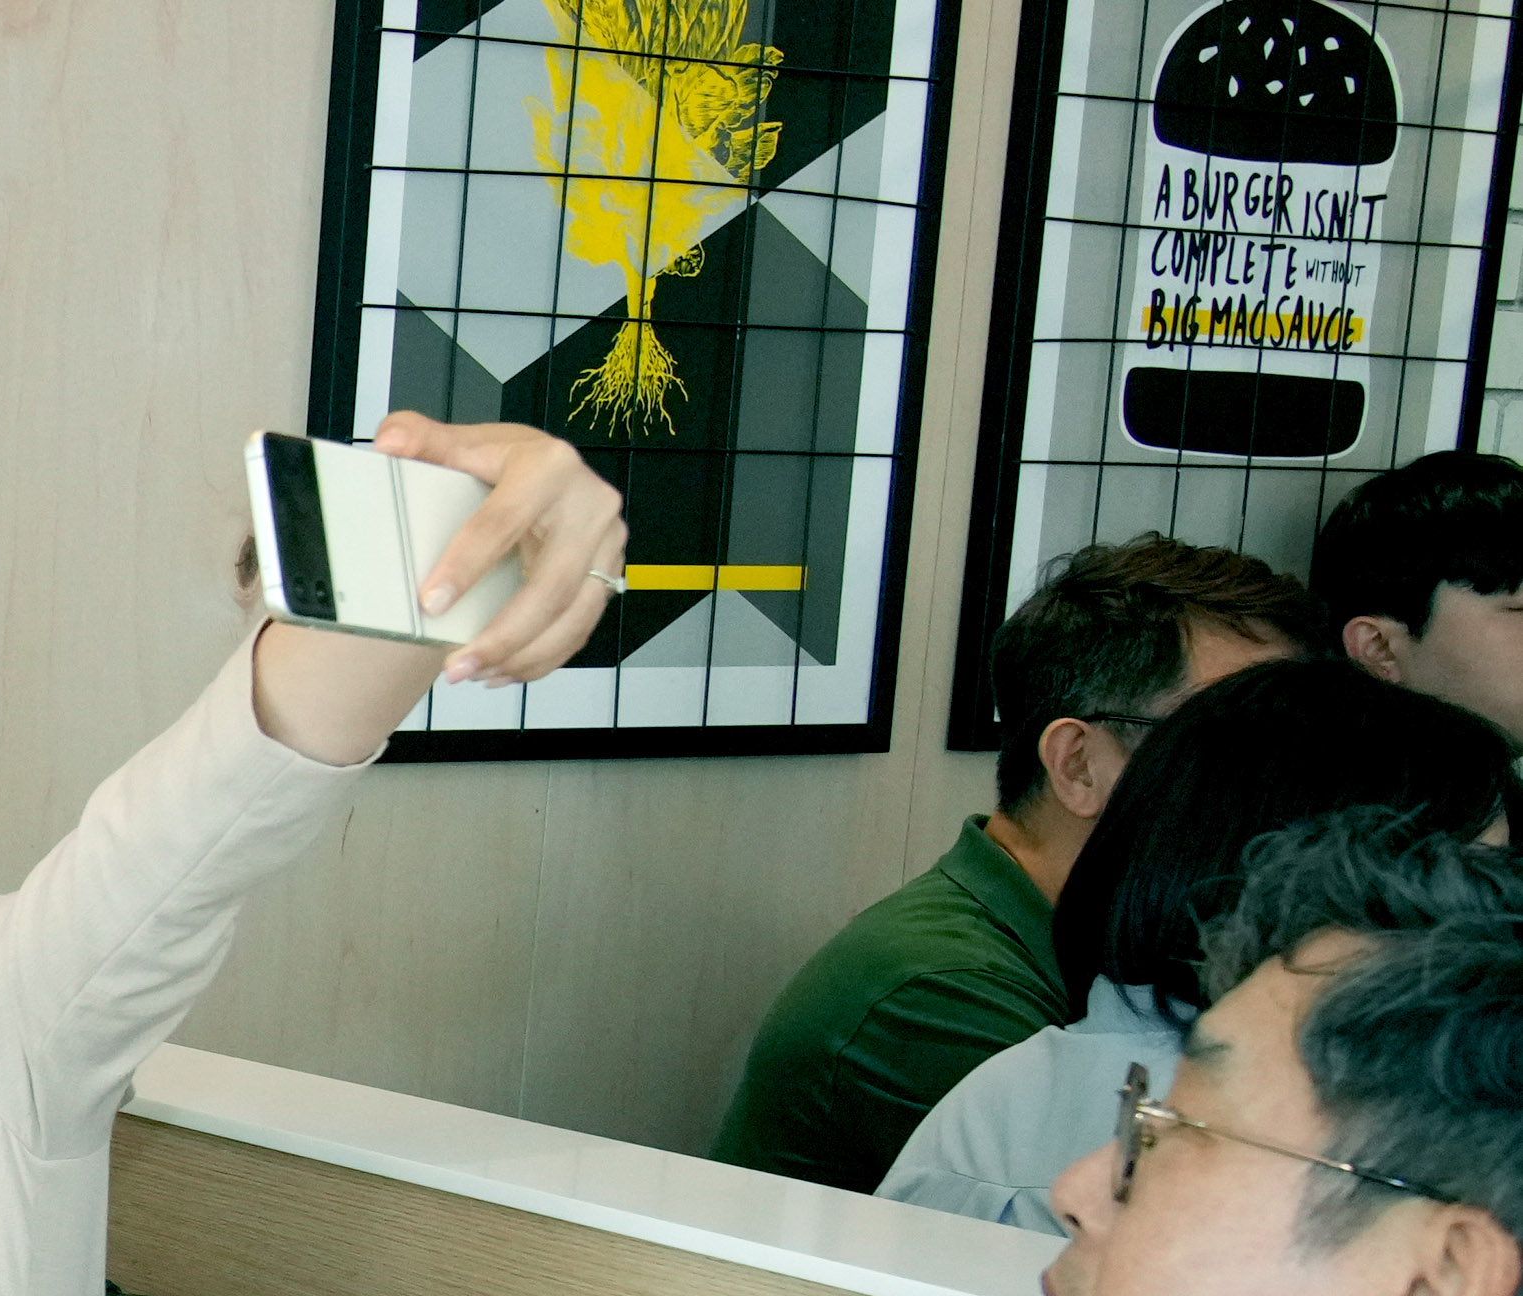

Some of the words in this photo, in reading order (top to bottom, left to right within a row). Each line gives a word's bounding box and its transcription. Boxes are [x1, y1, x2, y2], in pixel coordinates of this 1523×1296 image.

[1154, 164, 1171, 222] A
[1182, 168, 1293, 234] BURGER
[1151, 230, 1297, 294] COMPLETE
[1305, 258, 1367, 287] WITHOUT
[1146, 288, 1202, 352] BIG
[1208, 293, 1268, 348] MAC
[1270, 295, 1355, 351] SAUCE
